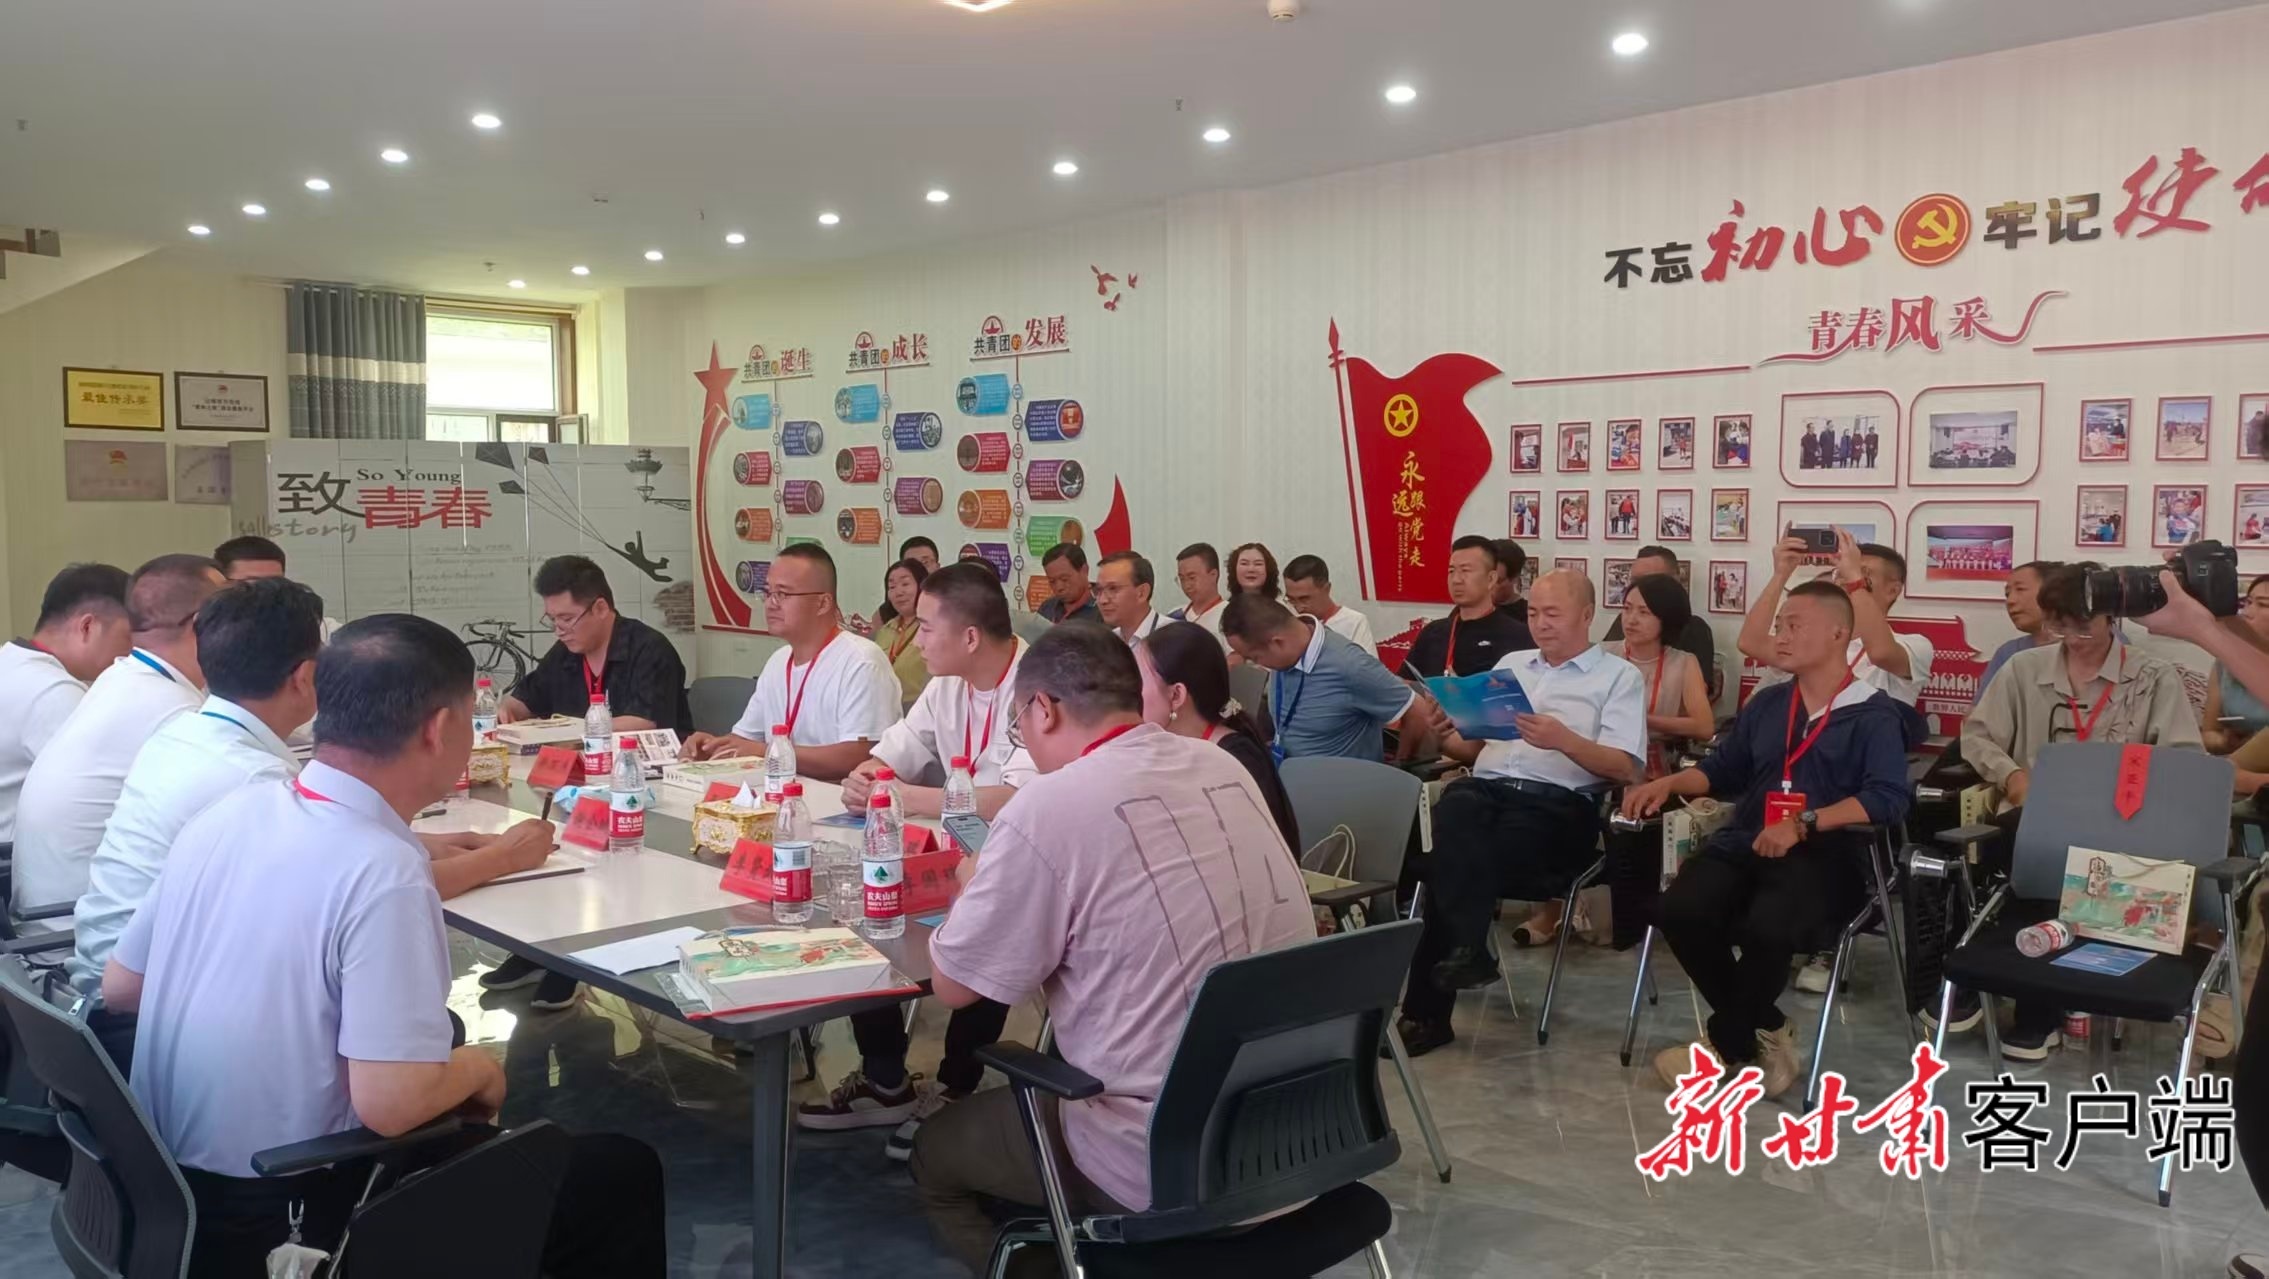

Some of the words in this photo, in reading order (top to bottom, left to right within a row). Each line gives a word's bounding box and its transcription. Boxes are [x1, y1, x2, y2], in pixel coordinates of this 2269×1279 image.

[1603, 199, 1884, 289] 不忘初心
[1808, 295, 1992, 352] 青春风采
[277, 471, 493, 529] 致青春
[356, 467, 384, 482] So
[394, 468, 462, 485] Young
